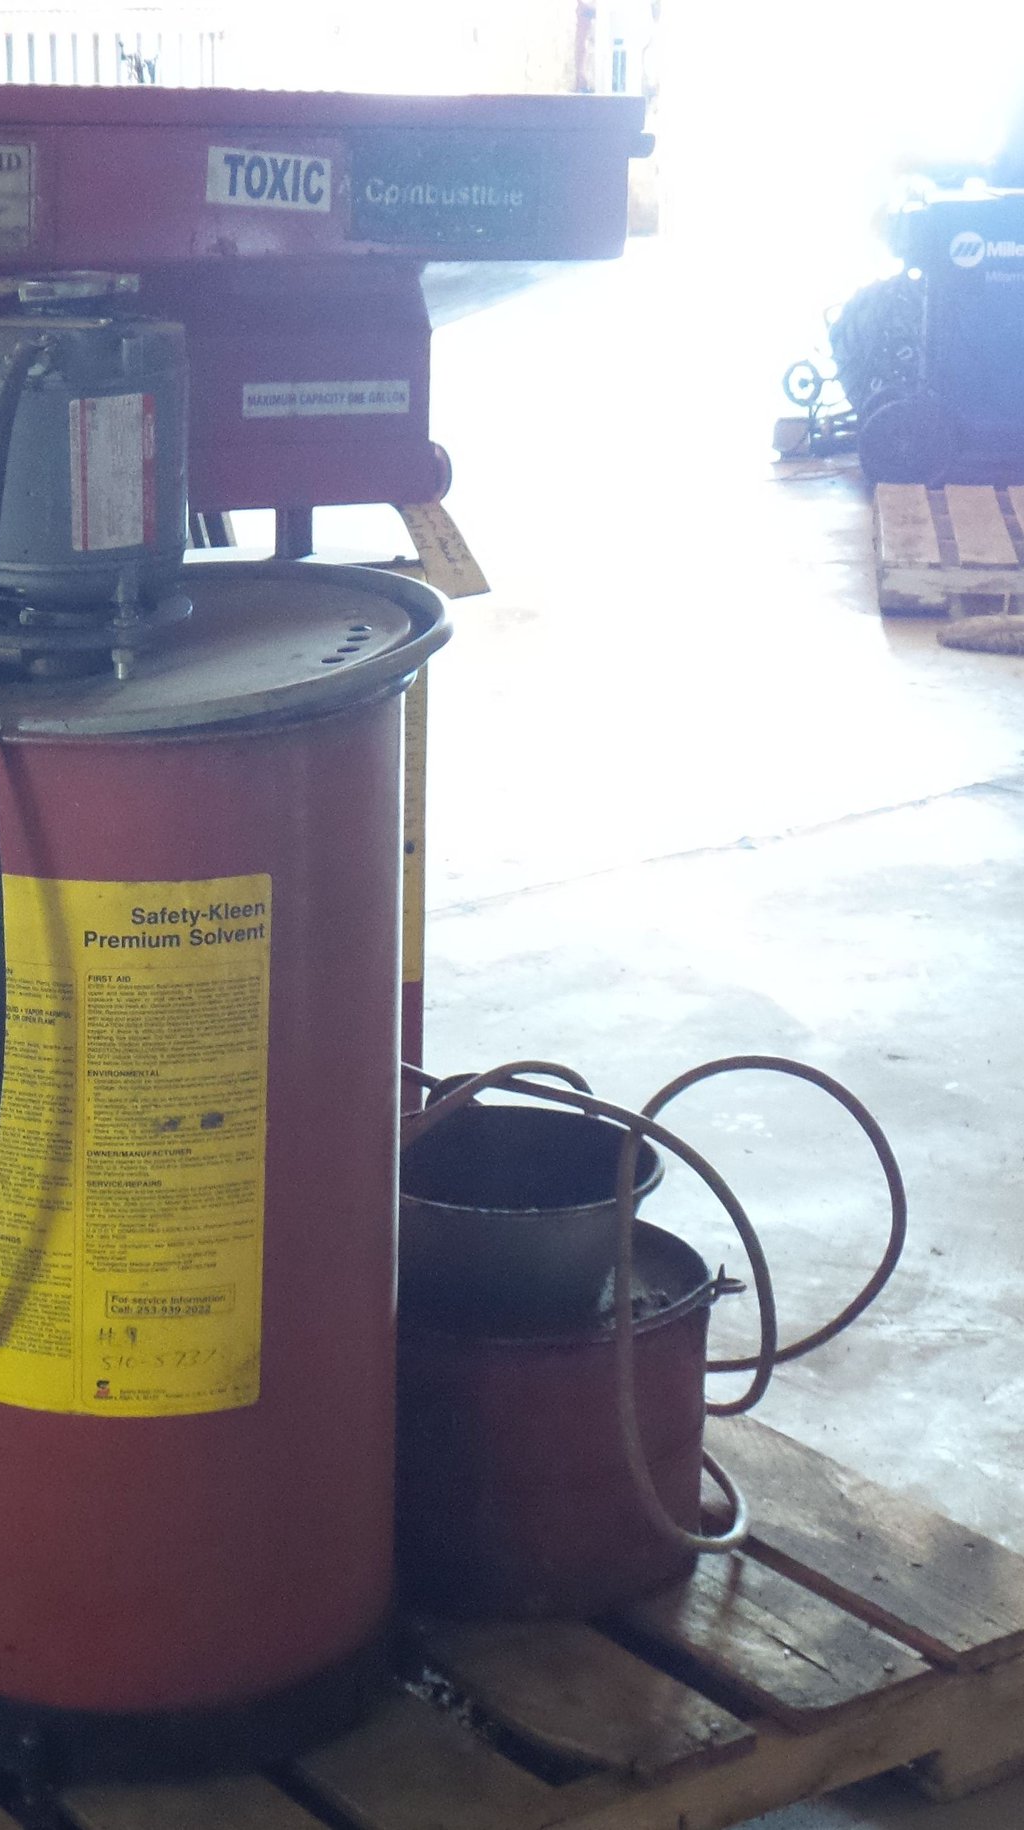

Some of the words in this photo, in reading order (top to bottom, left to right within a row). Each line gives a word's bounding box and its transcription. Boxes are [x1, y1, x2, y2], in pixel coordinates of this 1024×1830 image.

[224, 153, 326, 206] TOXIC
[131, 902, 266, 928] Safety-Kleen
[83, 930, 181, 949] Premium
[189, 923, 266, 947] Solvent
[87, 975, 113, 983] FIRST
[115, 975, 131, 983] AID
[87, 1069, 161, 1078] ENVIRONMENTAL
[86, 1180, 163, 1188] SERVICE/REPAIRS
[111, 1295, 128, 1304] For
[131, 1296, 167, 1305] service
